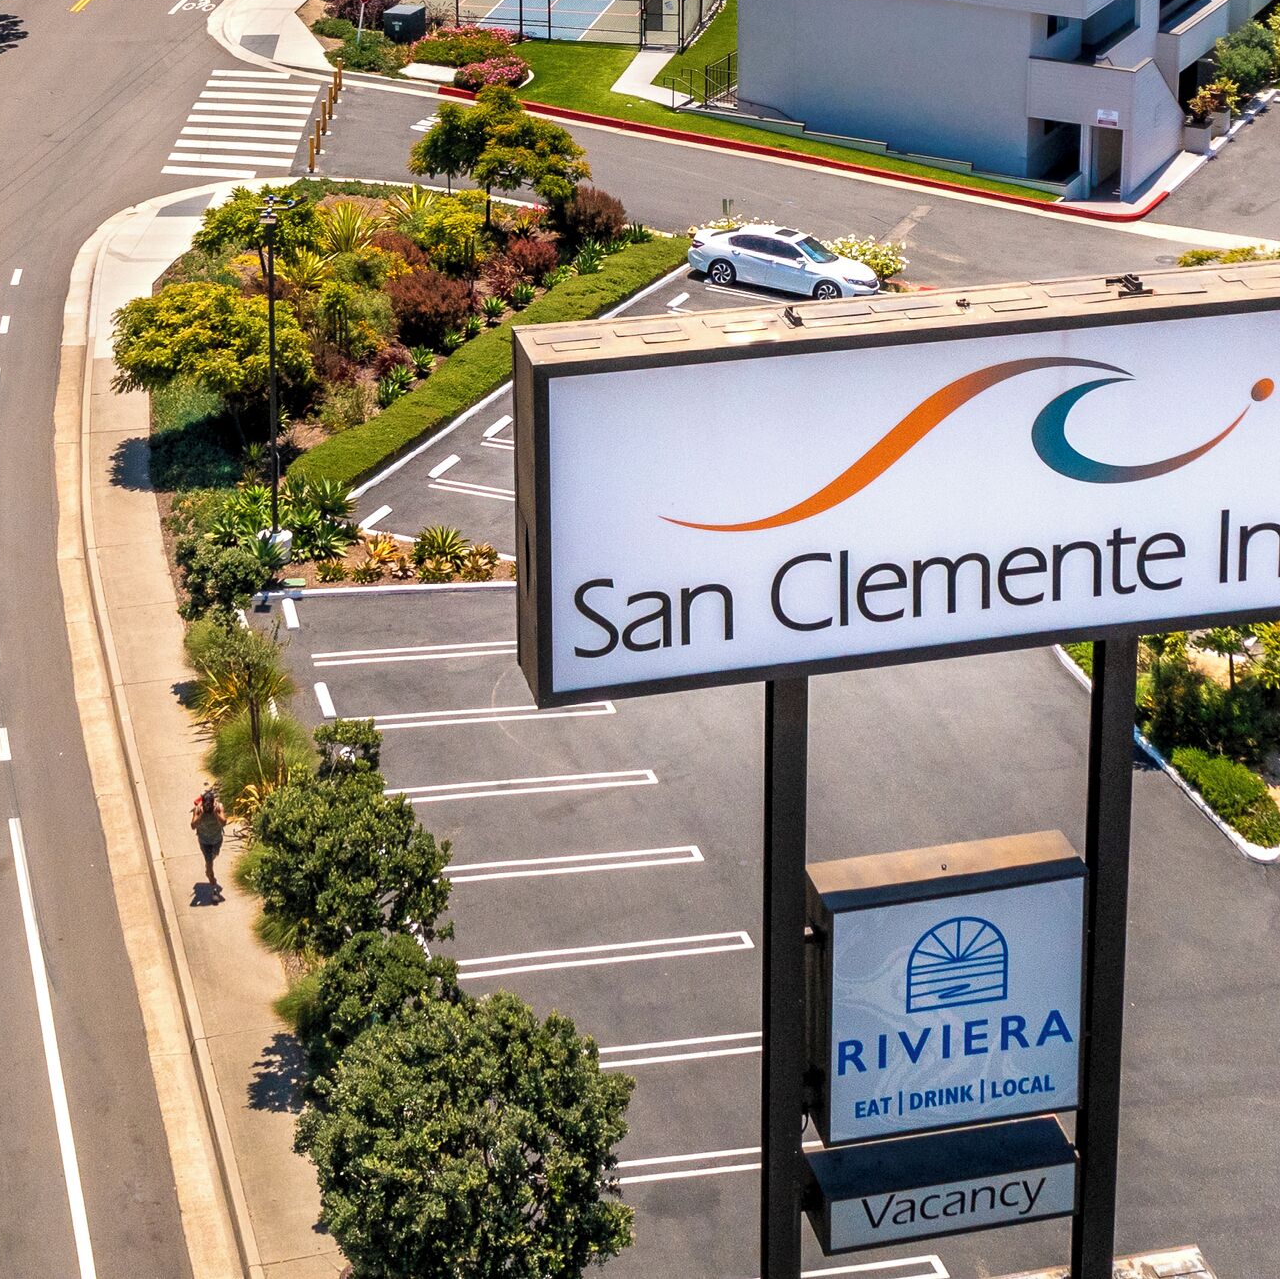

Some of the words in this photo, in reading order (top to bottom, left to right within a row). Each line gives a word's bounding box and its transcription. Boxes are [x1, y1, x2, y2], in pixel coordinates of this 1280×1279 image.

[574, 579, 734, 659] San
[771, 527, 1186, 632] Clemente
[837, 1009, 1074, 1077] RIVIERA
[855, 1097, 893, 1119] EAT
[910, 1085, 974, 1110] DRINK
[991, 1075, 1056, 1100] LOCAL
[862, 1177, 1047, 1229] Vacancy
